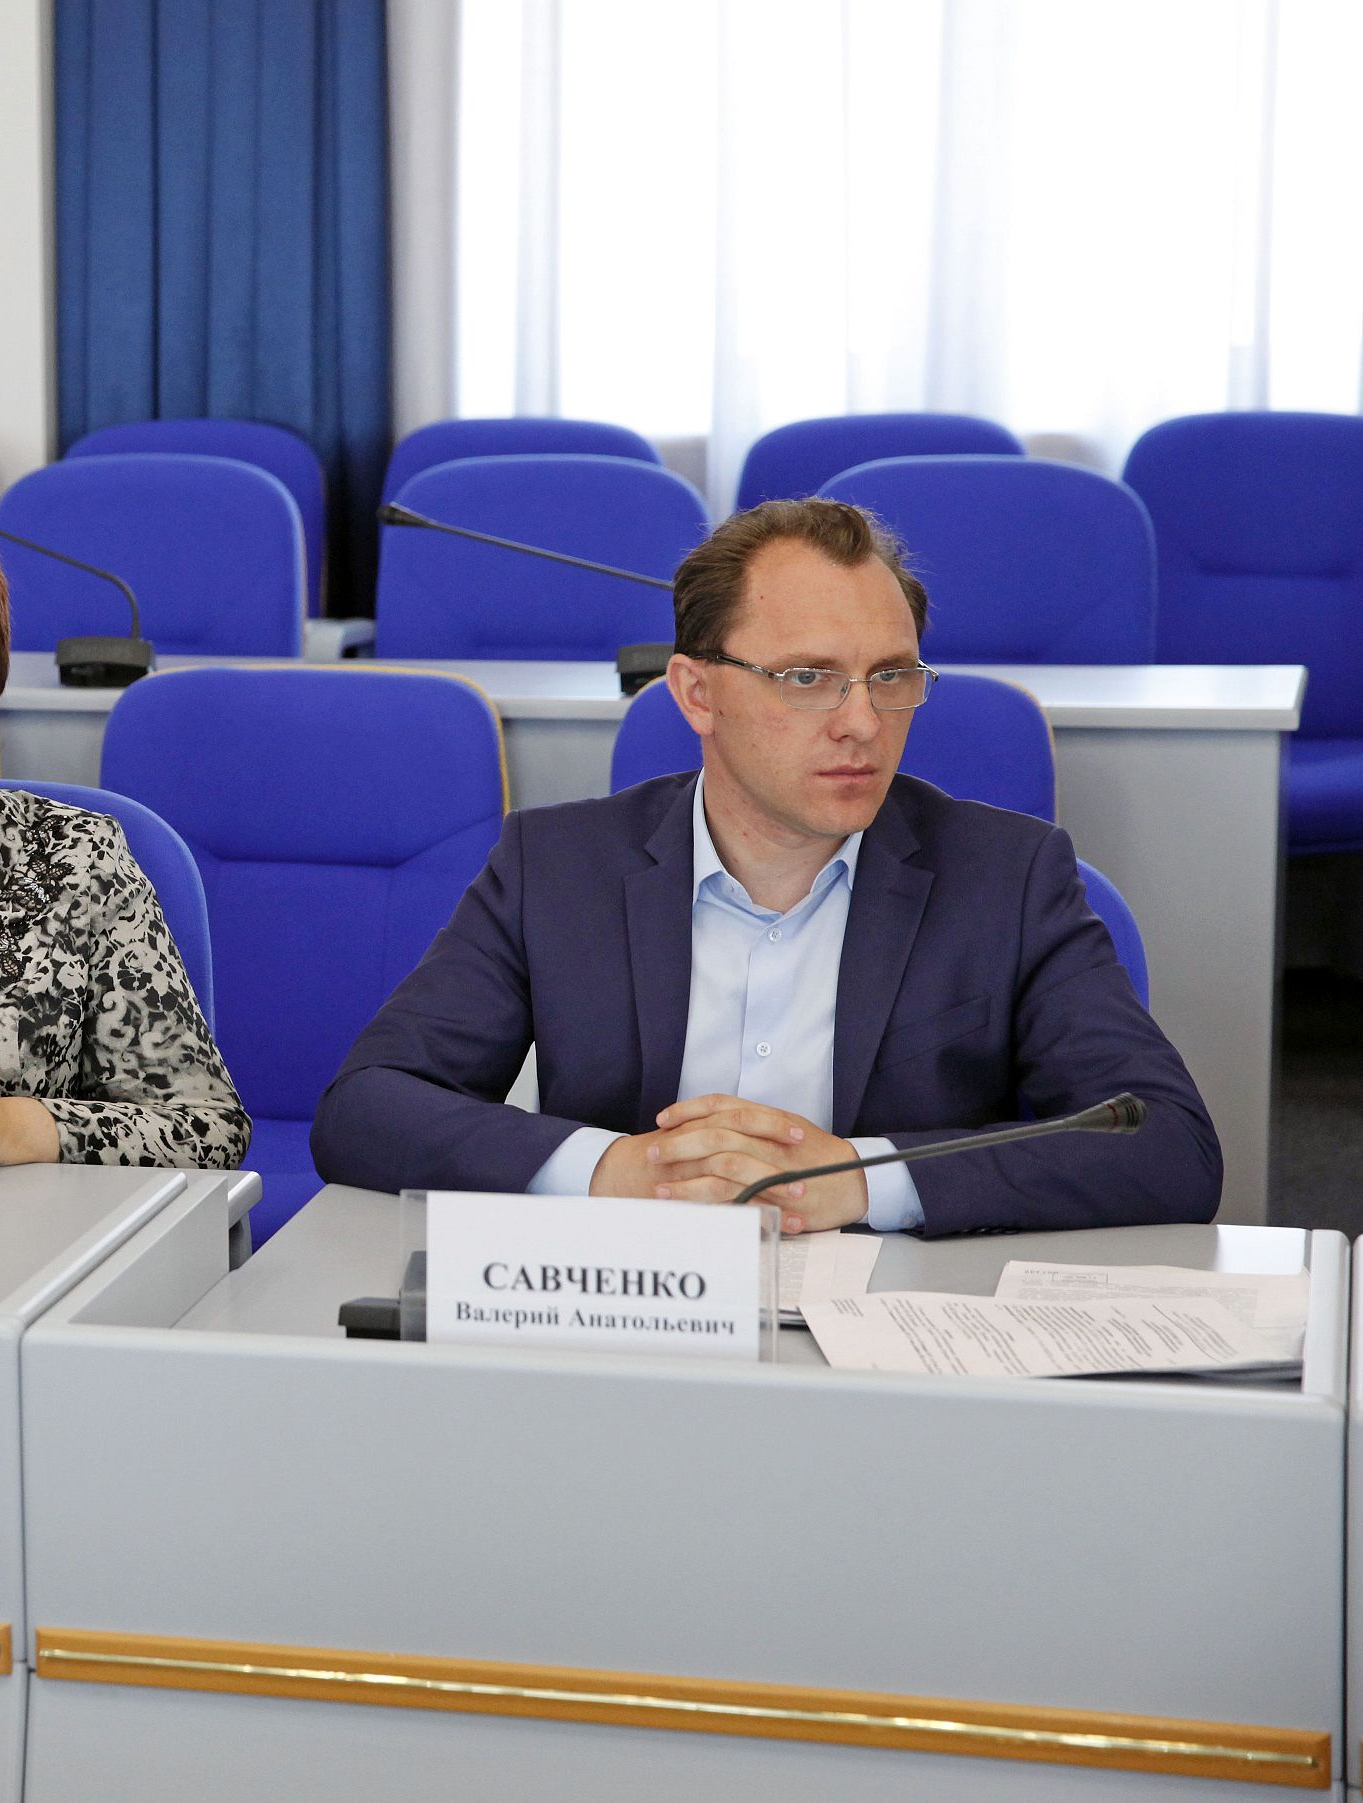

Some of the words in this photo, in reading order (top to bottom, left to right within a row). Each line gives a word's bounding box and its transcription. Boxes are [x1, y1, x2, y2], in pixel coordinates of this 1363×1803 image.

[483, 1262, 706, 1299] САВЧЕНКО
[456, 1302, 560, 1329] Валерий
[569, 1309, 735, 1336] Анатольевич
